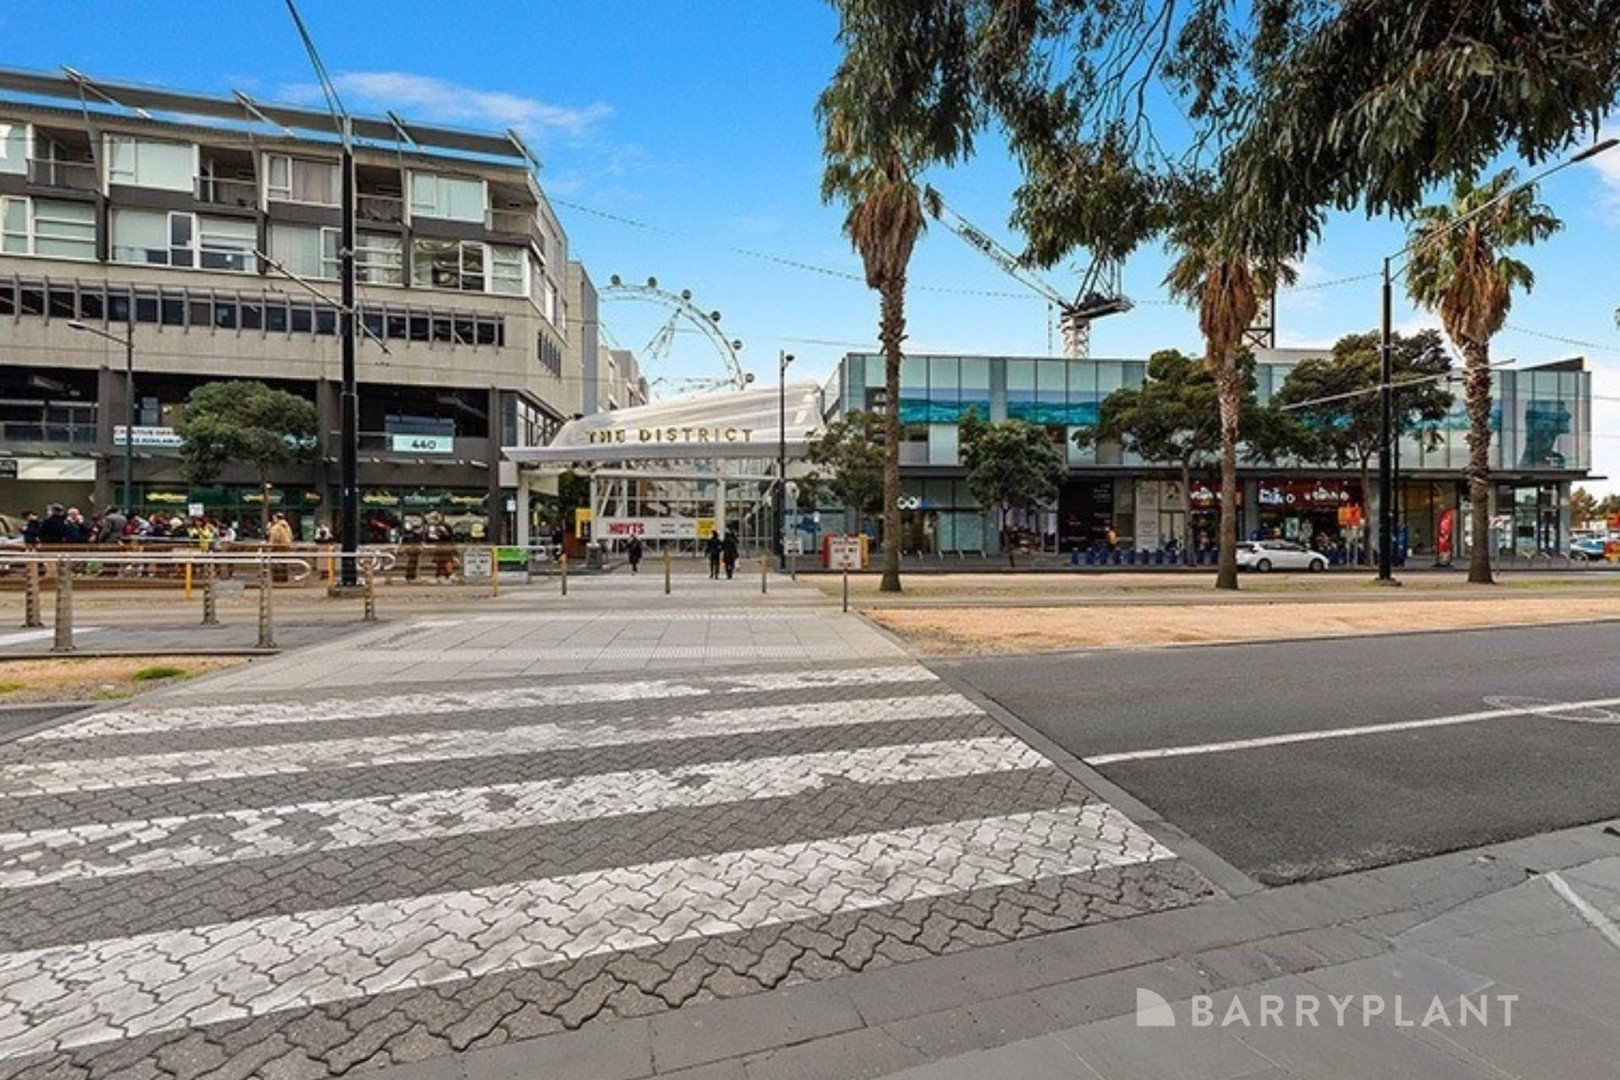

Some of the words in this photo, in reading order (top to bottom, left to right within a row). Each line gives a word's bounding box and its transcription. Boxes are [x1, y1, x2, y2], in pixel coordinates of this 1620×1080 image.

[585, 429, 625, 443] THE
[639, 427, 753, 443] DISTRICT
[412, 439, 437, 450] 440
[609, 523, 645, 536] HOYTS
